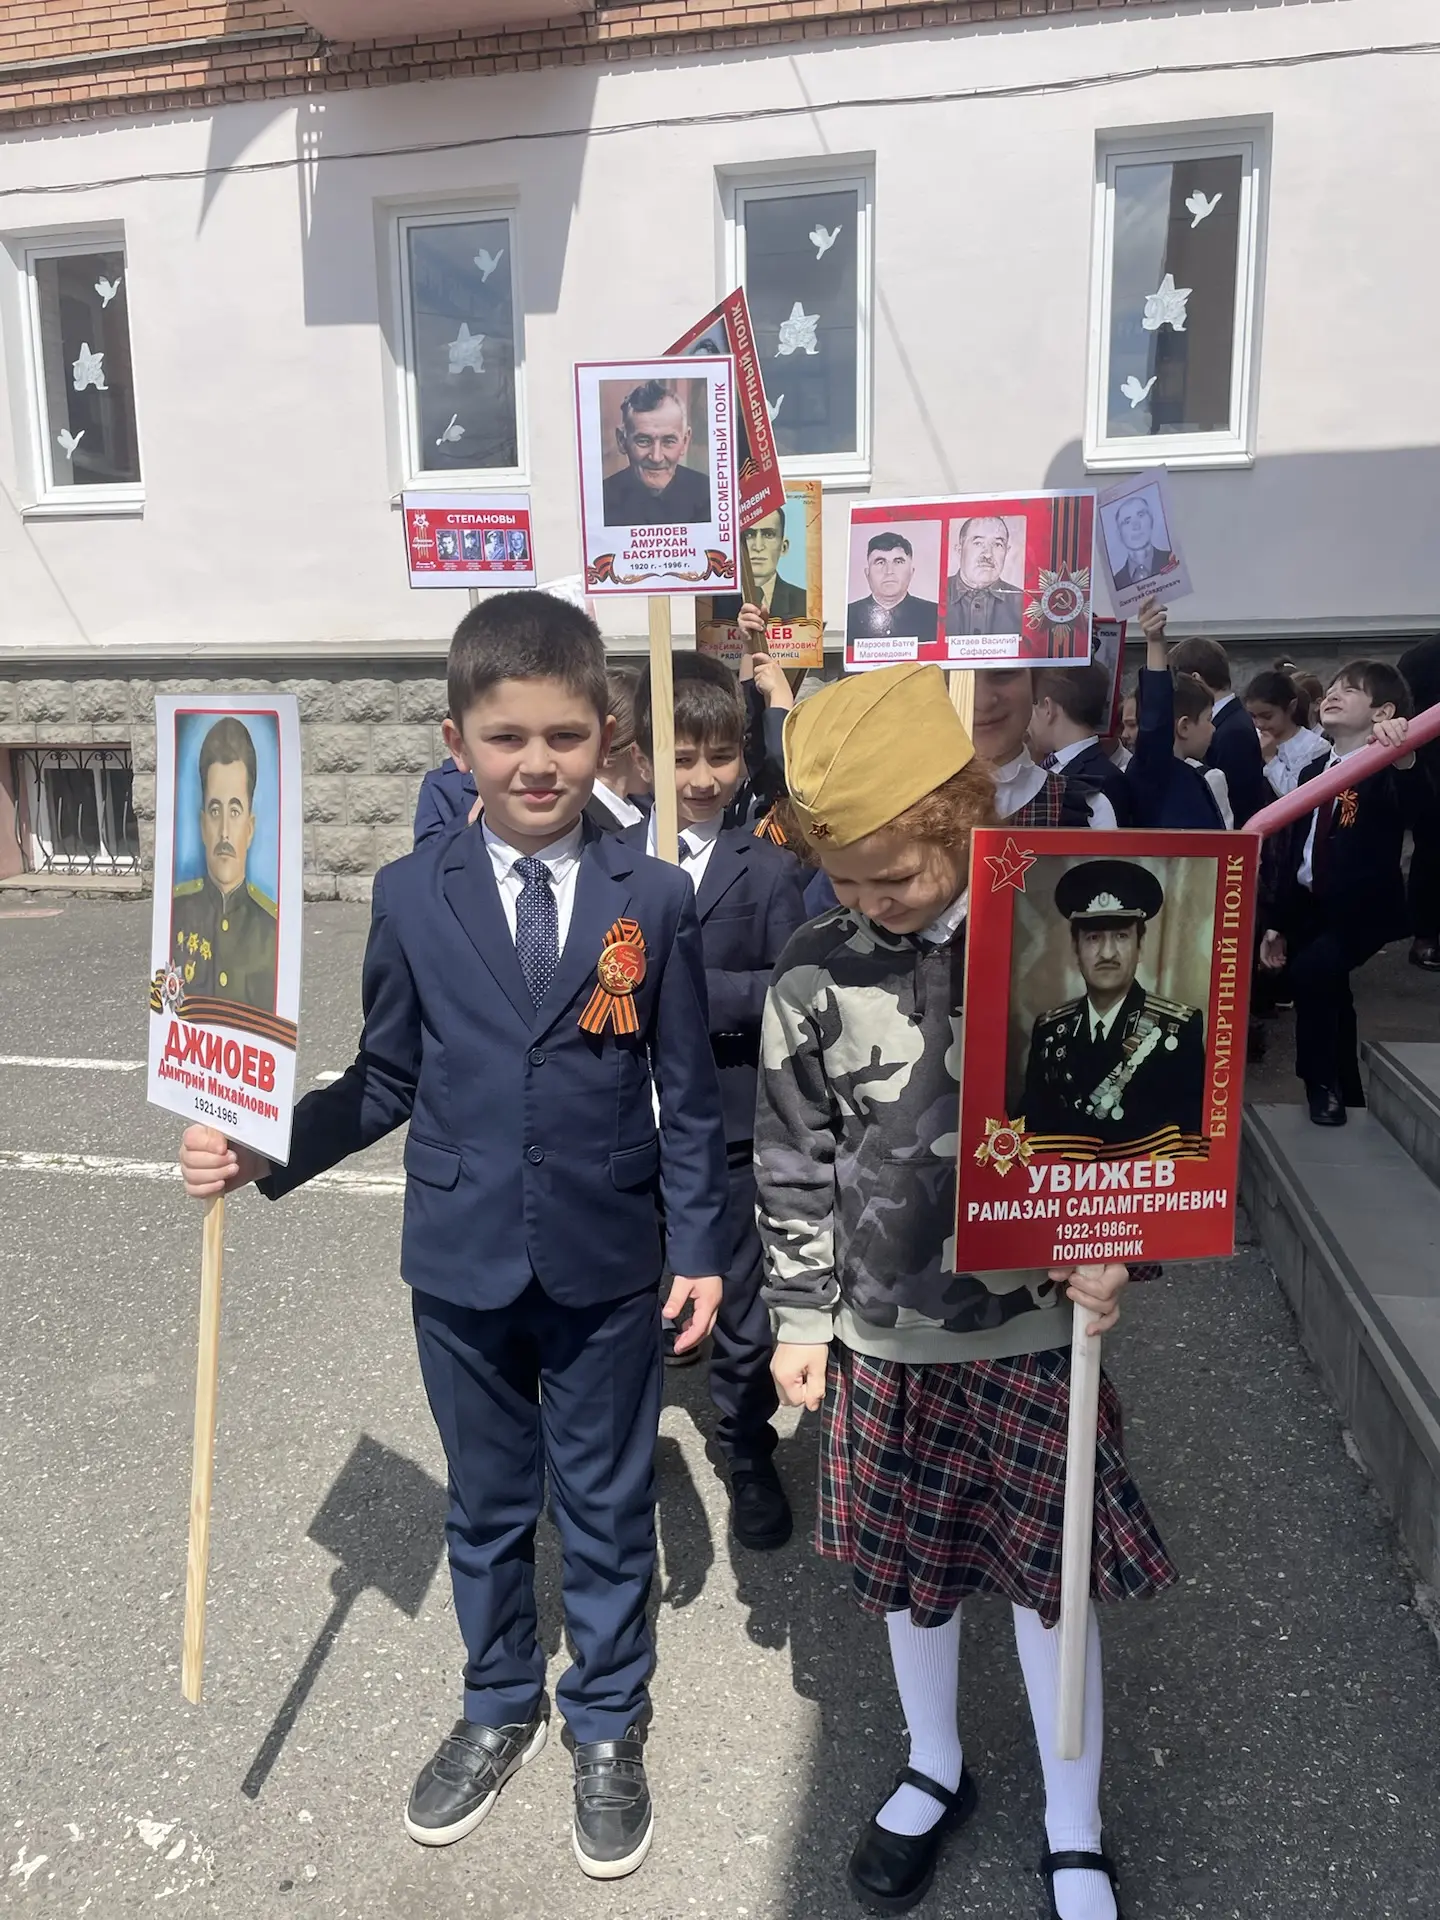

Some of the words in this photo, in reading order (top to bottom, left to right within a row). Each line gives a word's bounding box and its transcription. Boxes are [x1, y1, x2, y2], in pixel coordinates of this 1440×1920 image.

[731, 301, 749, 350] ПОЛК
[715, 383, 727, 423] ПОЛК
[738, 351, 772, 472] БЕССМЕРТНЫЙ
[713, 428, 730, 542] БЕССМЕРТНЫЙ
[446, 514, 516, 525] СТЕПАНОВЫ
[630, 527, 688, 537] БОЛЛОЕВ
[623, 548, 696, 560] БАСЯТОВИЧ
[631, 537, 688, 548] АМУРХАН
[856, 640, 891, 649] Марзоев
[859, 649, 912, 659] Магомедович
[951, 637, 980, 646] Катаев
[981, 635, 1017, 645] Василий
[959, 646, 1007, 657] Сафарович
[1223, 854, 1244, 928] ПОЛК
[1209, 937, 1239, 1138] БЕССМЕРТНЫЙ
[164, 1020, 276, 1093] ДЖИОЕВ
[158, 1058, 205, 1090] Дмитрий
[207, 1076, 279, 1122] Михайлович
[194, 1097, 238, 1125] 1921-1965
[1028, 1160, 1176, 1193] УВИЖЕВ
[967, 1199, 1060, 1222] РАМАЗАН
[1066, 1189, 1227, 1217] САЛАМГЕРИЕВИЧ
[1056, 1221, 1142, 1240] 1922-1986гг.
[1053, 1240, 1143, 1261] ПОЛКОВНИК
